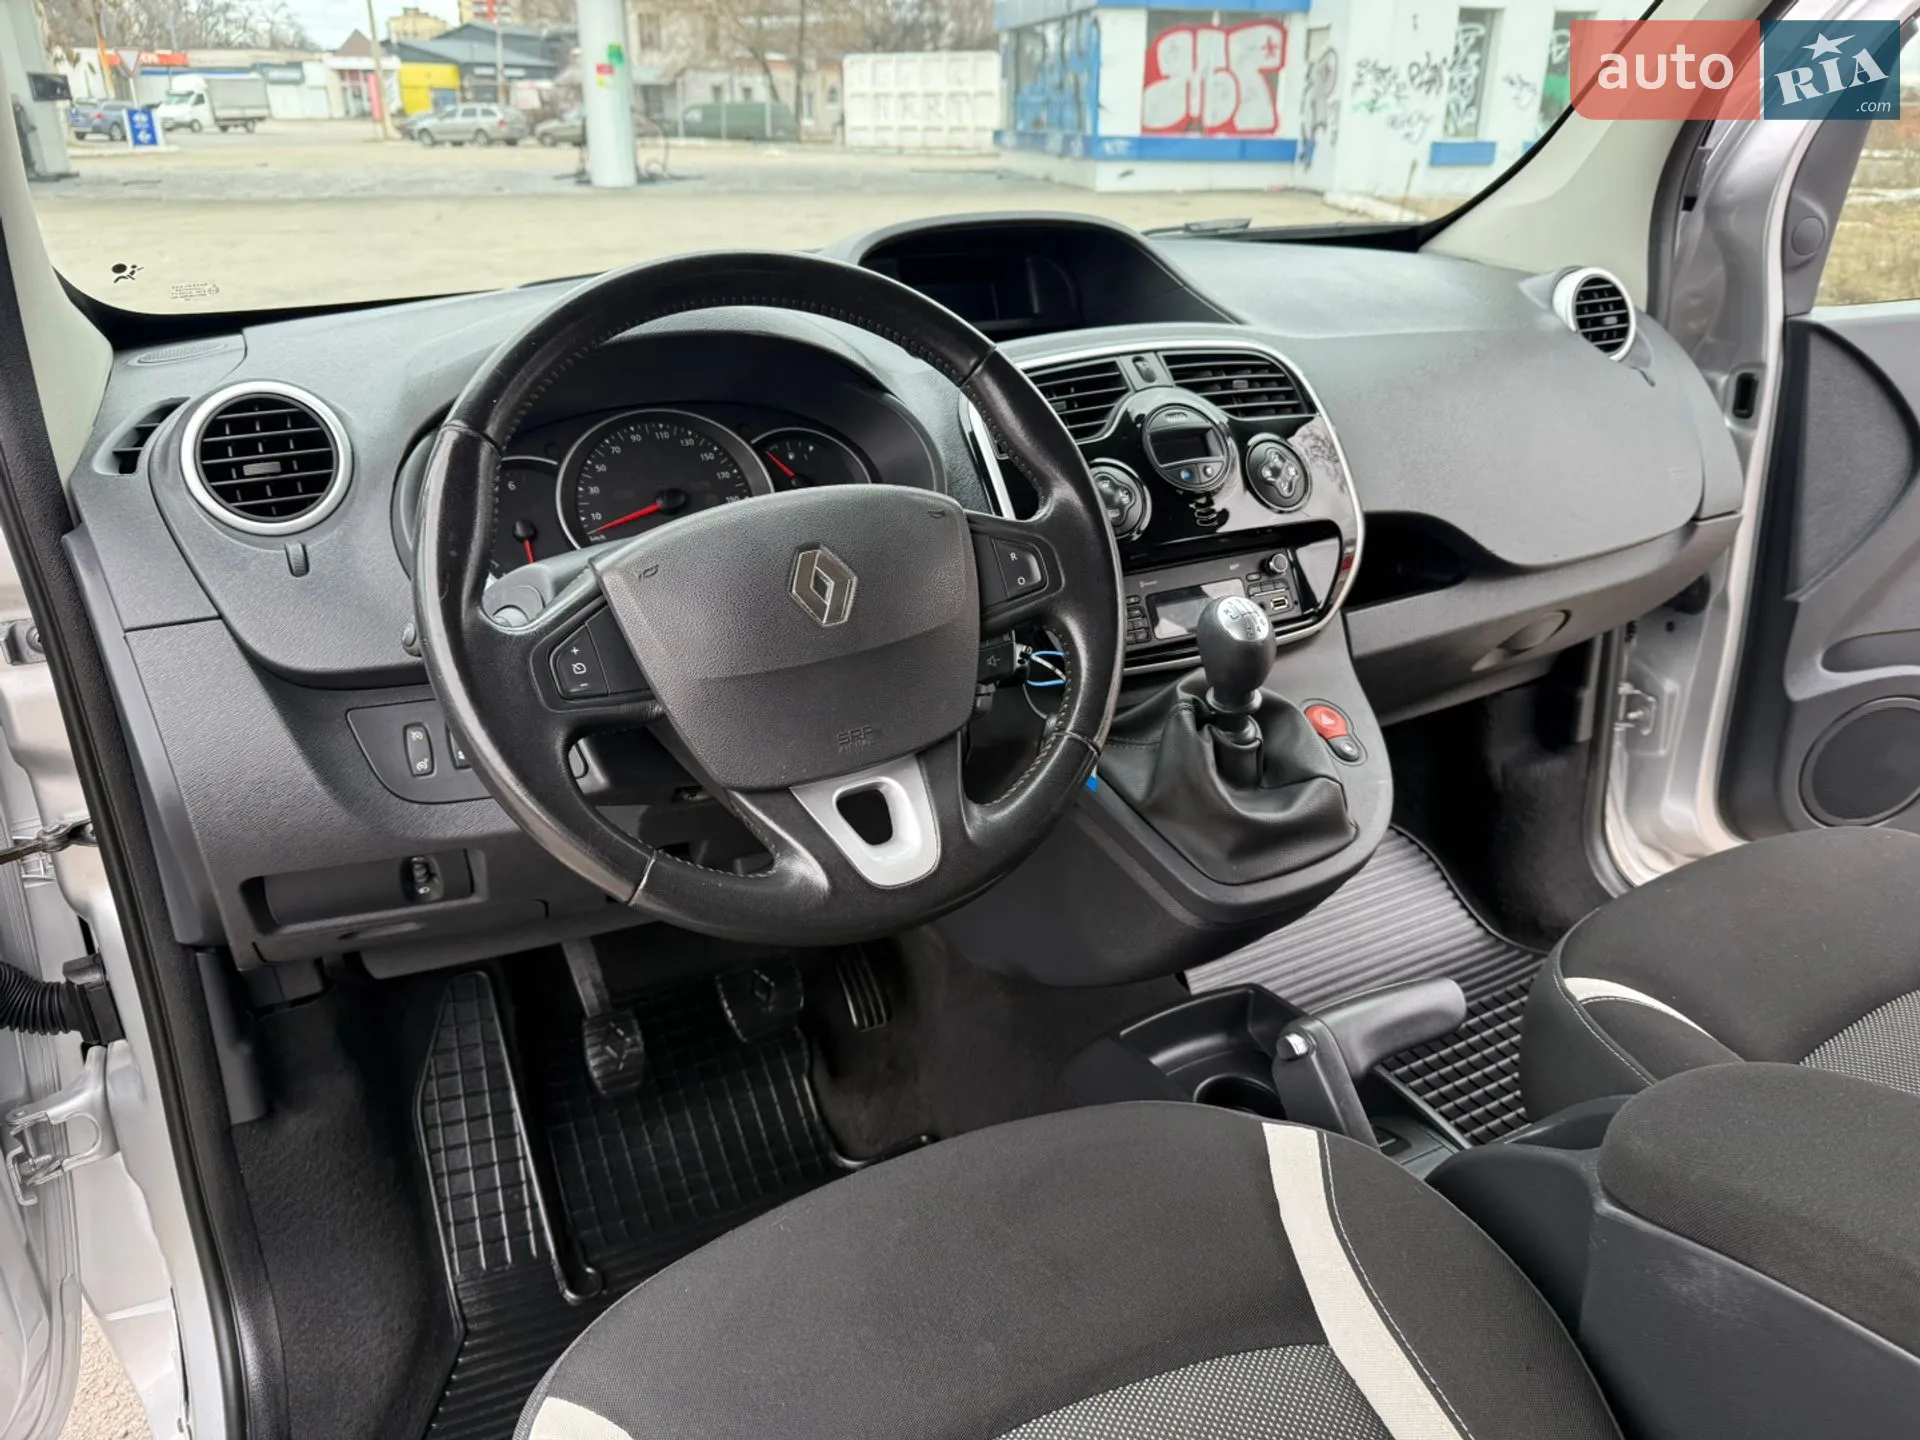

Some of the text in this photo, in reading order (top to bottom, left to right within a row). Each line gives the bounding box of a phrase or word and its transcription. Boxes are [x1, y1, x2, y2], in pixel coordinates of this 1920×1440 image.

[630, 433, 641, 442] 90
[655, 431, 670, 440] 110
[680, 438, 695, 447] 130
[610, 445, 621, 455] 70
[595, 463, 607, 473] 50
[507, 480, 517, 491] 6
[588, 485, 600, 495] 30
[590, 512, 602, 521] 10
[1009, 551, 1018, 561] R
